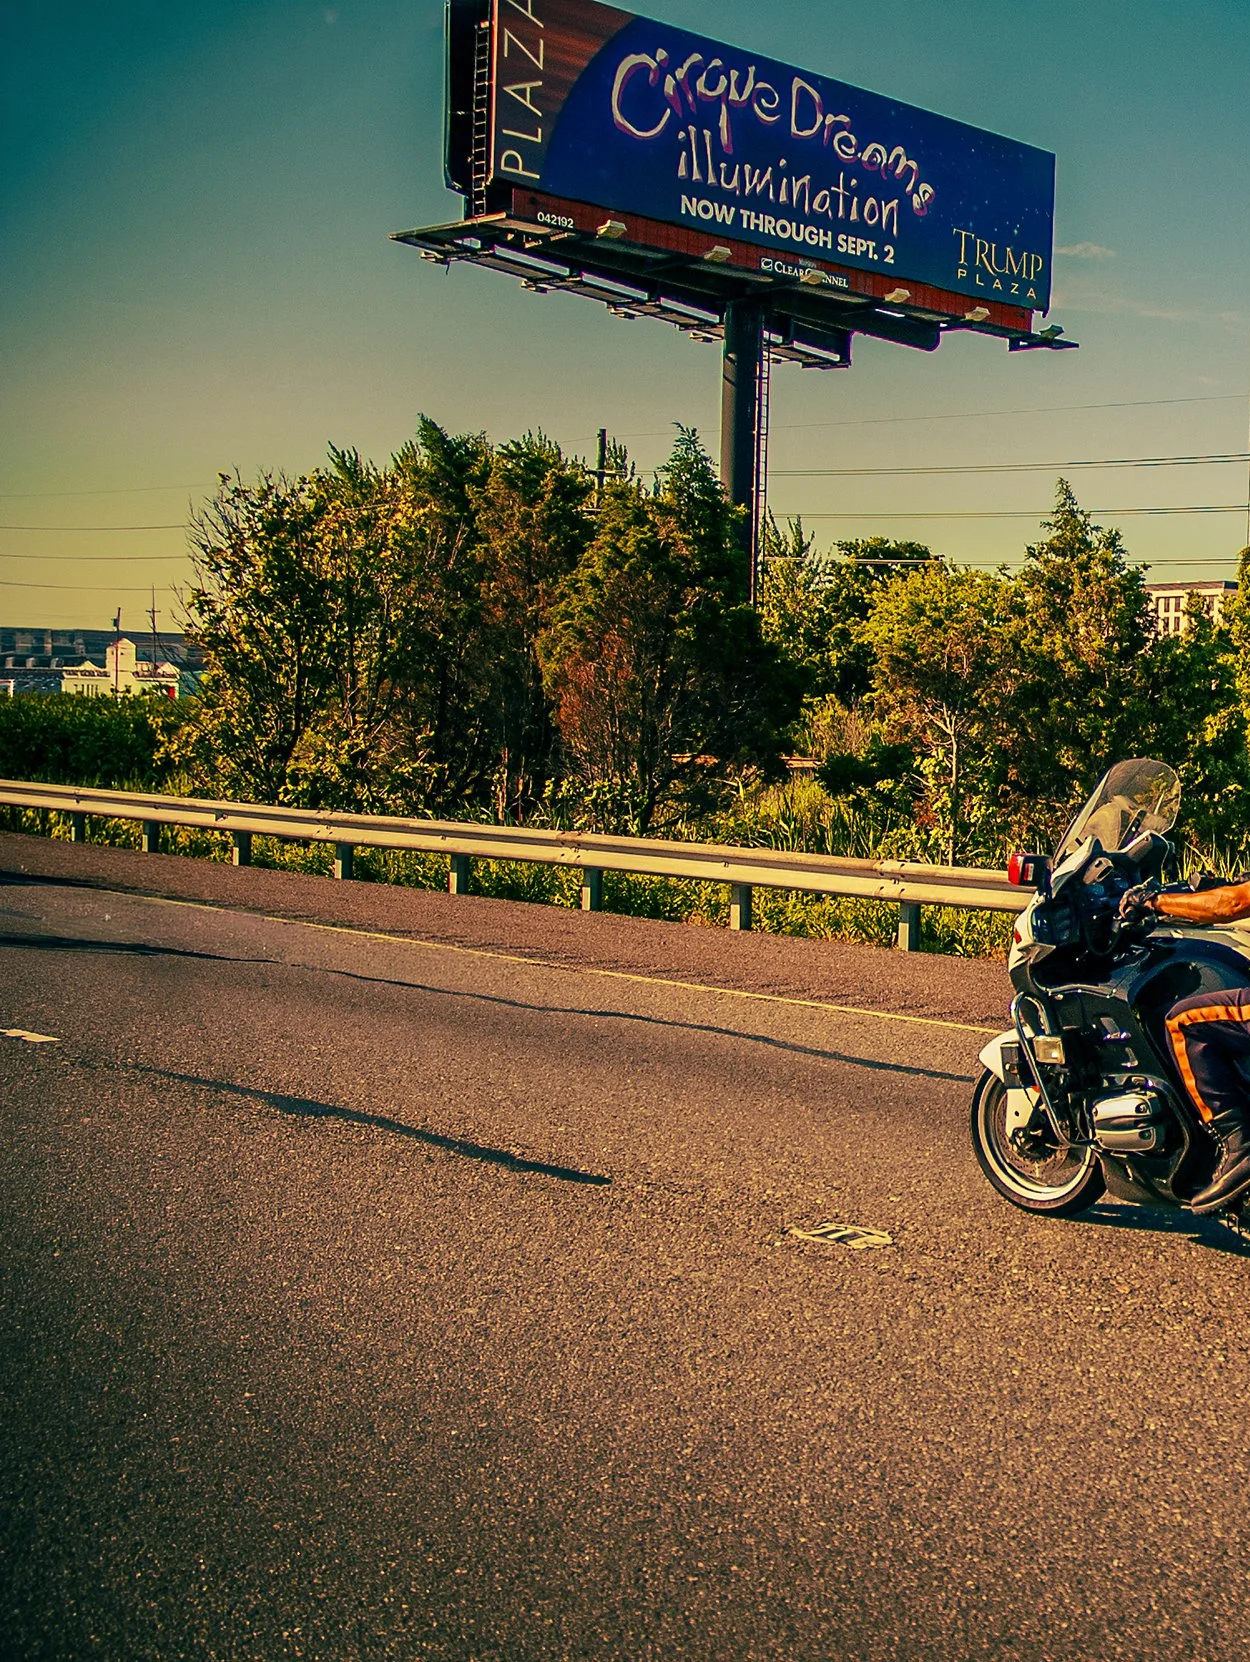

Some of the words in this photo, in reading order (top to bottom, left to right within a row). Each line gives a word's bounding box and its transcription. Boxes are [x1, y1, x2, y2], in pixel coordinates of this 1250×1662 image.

[611, 48, 781, 154] Cirque
[791, 76, 935, 217] Dreams
[677, 124, 899, 238] illumination
[537, 211, 574, 229] 042192
[680, 194, 735, 225] NOW
[739, 208, 833, 249] THROUGH
[837, 233, 879, 261] SEPT.
[884, 245, 895, 265] 2
[953, 227, 1043, 281] TRUMP
[957, 268, 1037, 299] PLAZA
